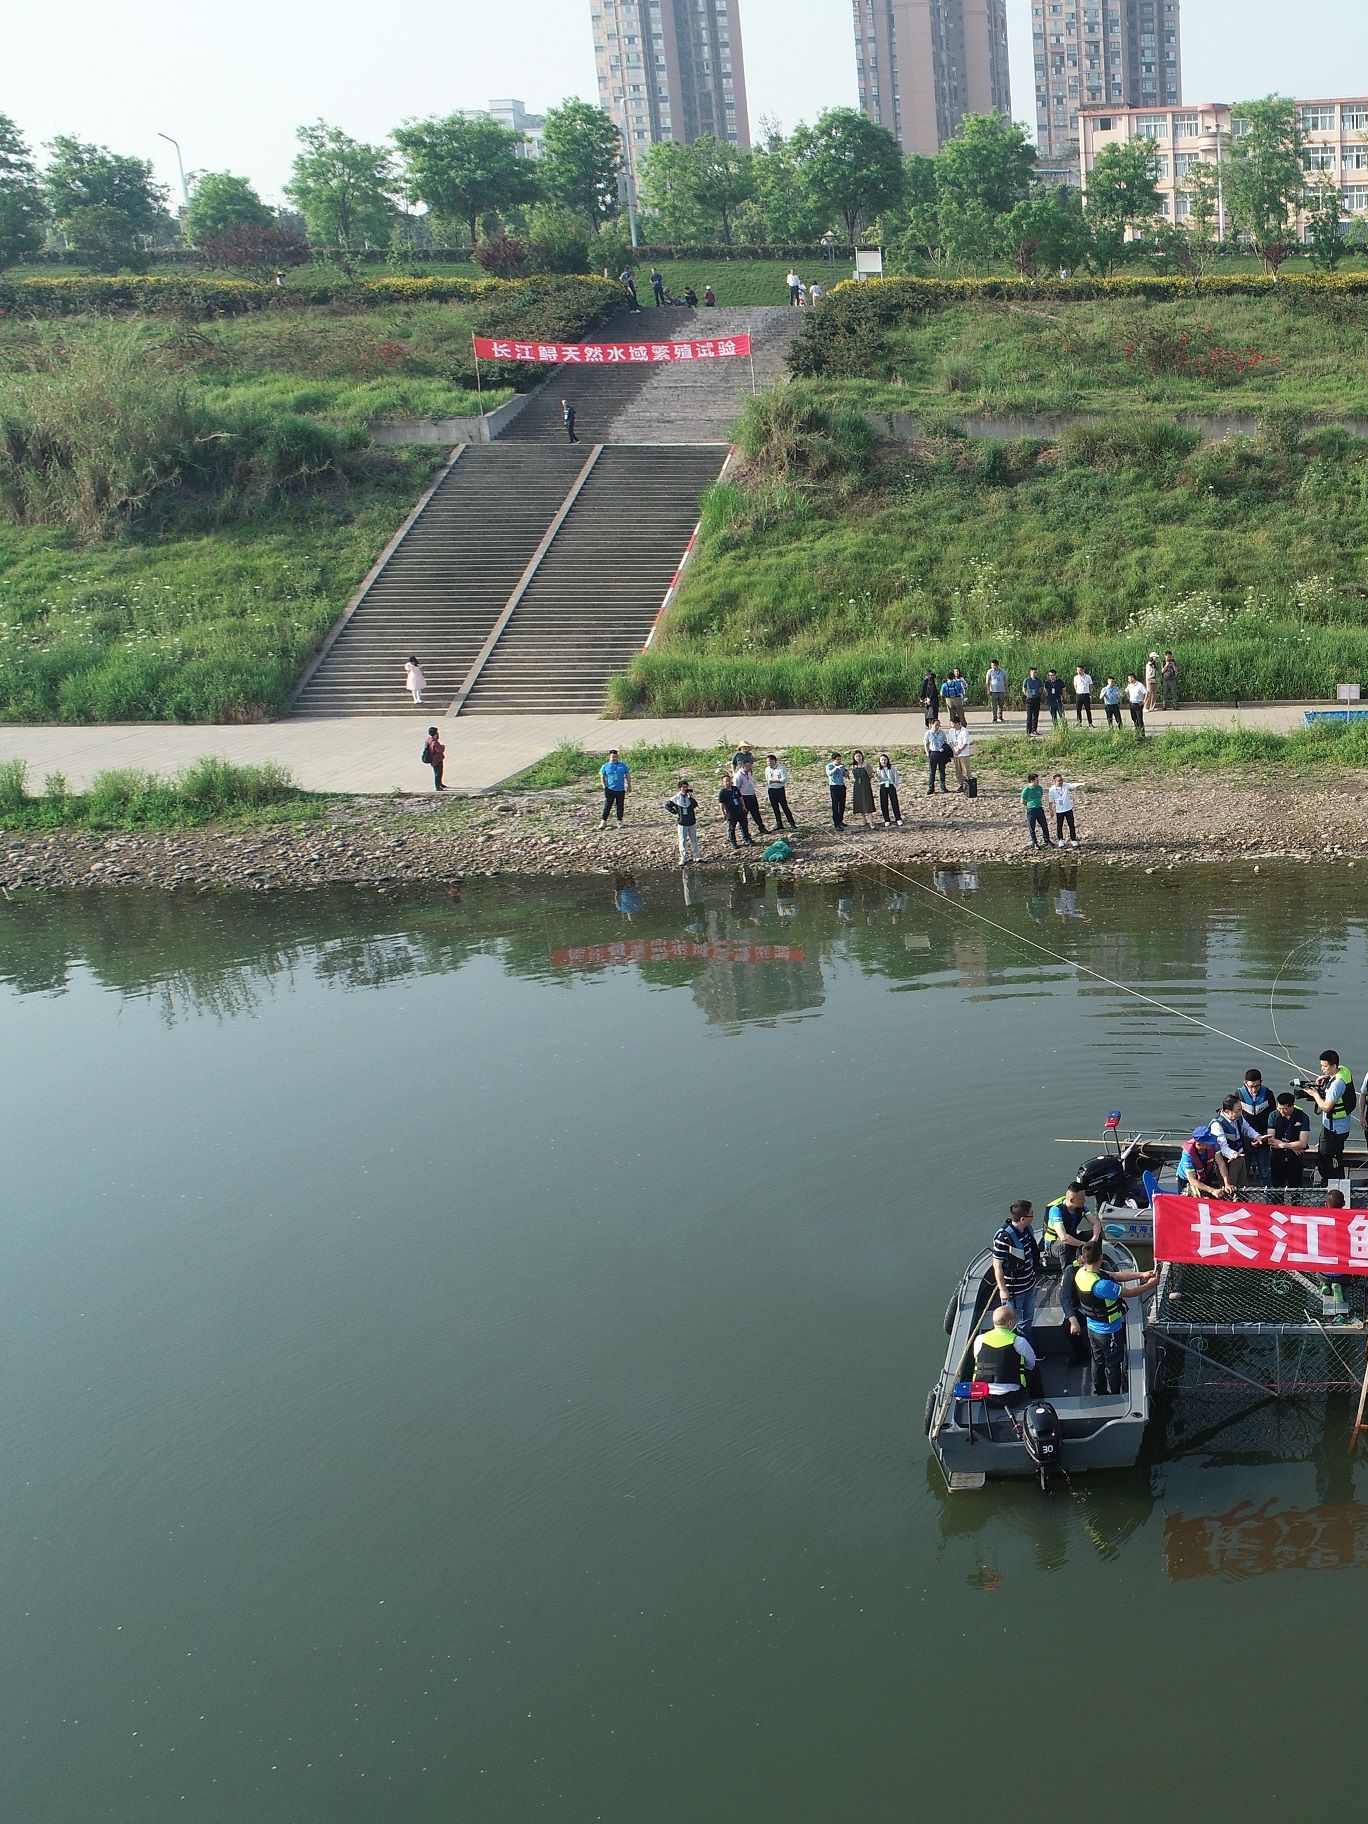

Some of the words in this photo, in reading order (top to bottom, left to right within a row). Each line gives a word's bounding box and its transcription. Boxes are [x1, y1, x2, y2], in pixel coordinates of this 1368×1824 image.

[492, 341, 736, 362] 长江鲟天然水域繁殖试验
[1042, 1444, 1054, 1454] 30
